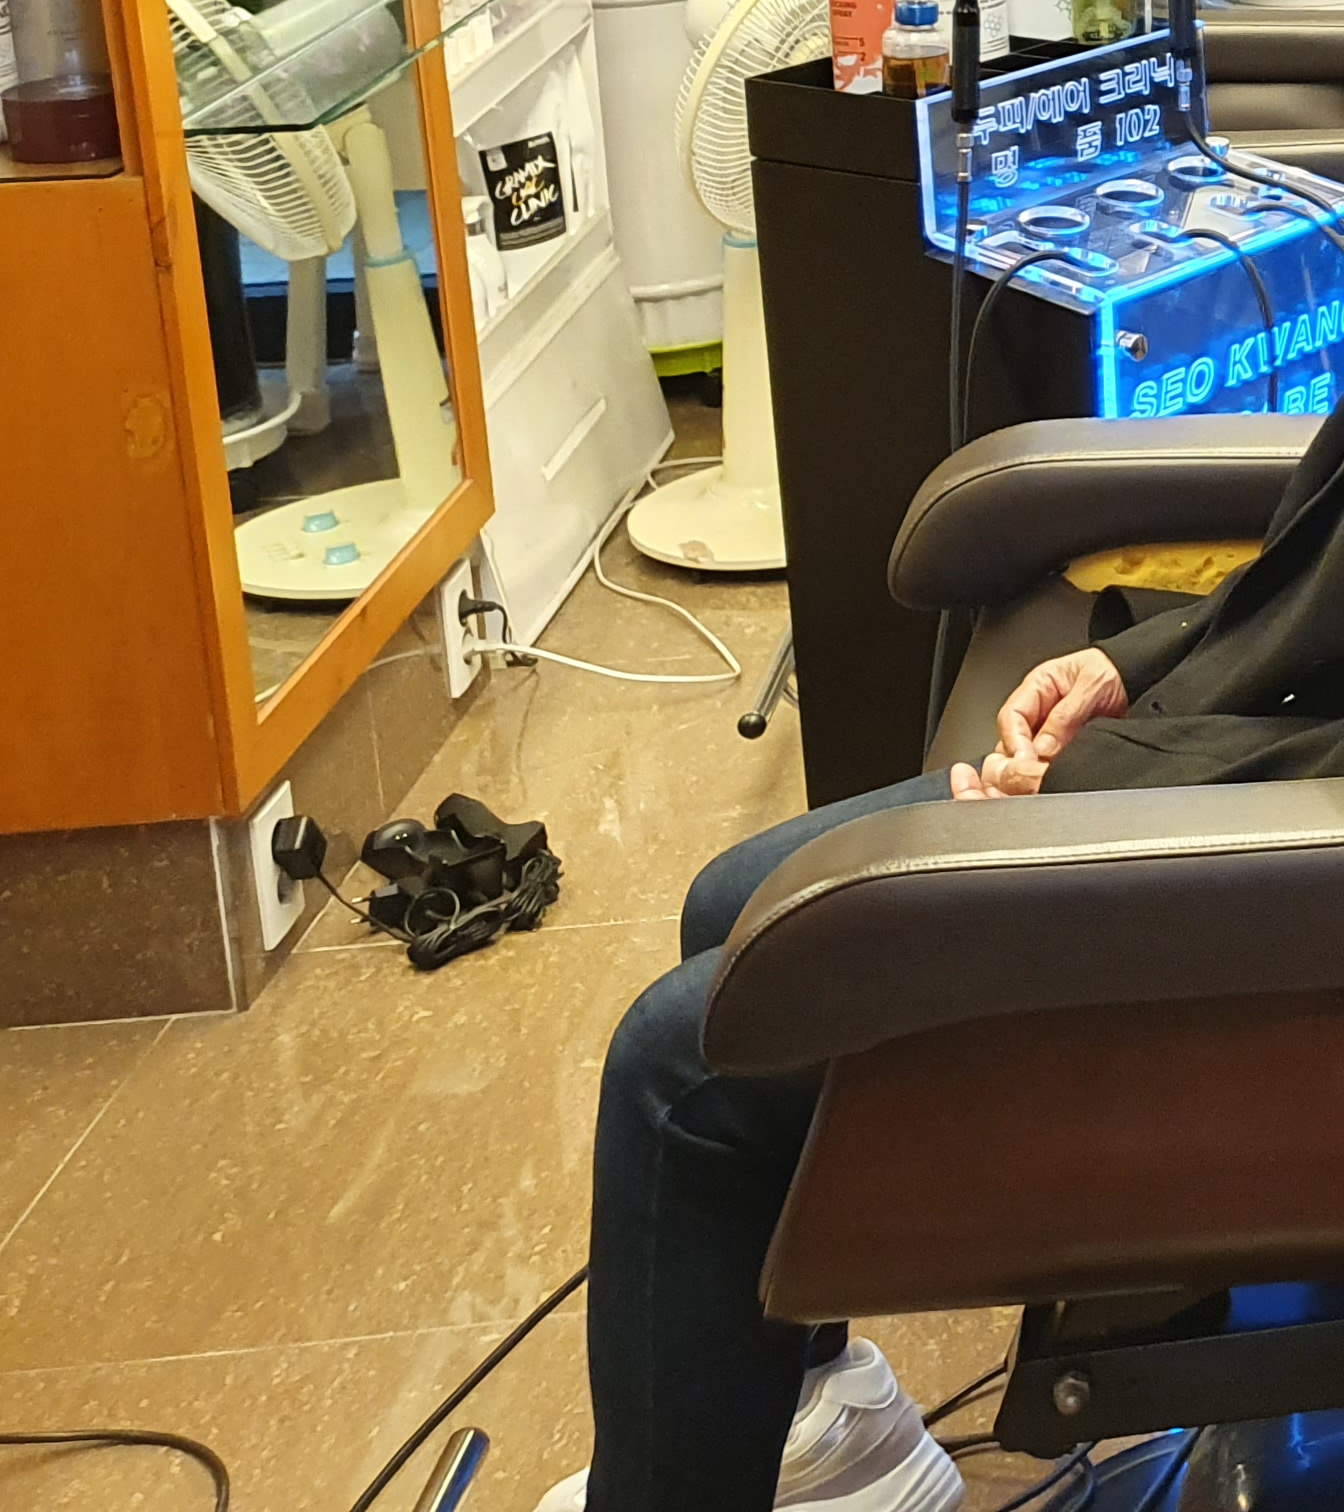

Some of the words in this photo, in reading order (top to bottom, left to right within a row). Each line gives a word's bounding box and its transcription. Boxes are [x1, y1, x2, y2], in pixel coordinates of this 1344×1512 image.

[1097, 52, 1177, 106] 크리닉
[1075, 119, 1103, 162] 품
[1116, 103, 1162, 147] 102
[1130, 356, 1216, 418] SEO
